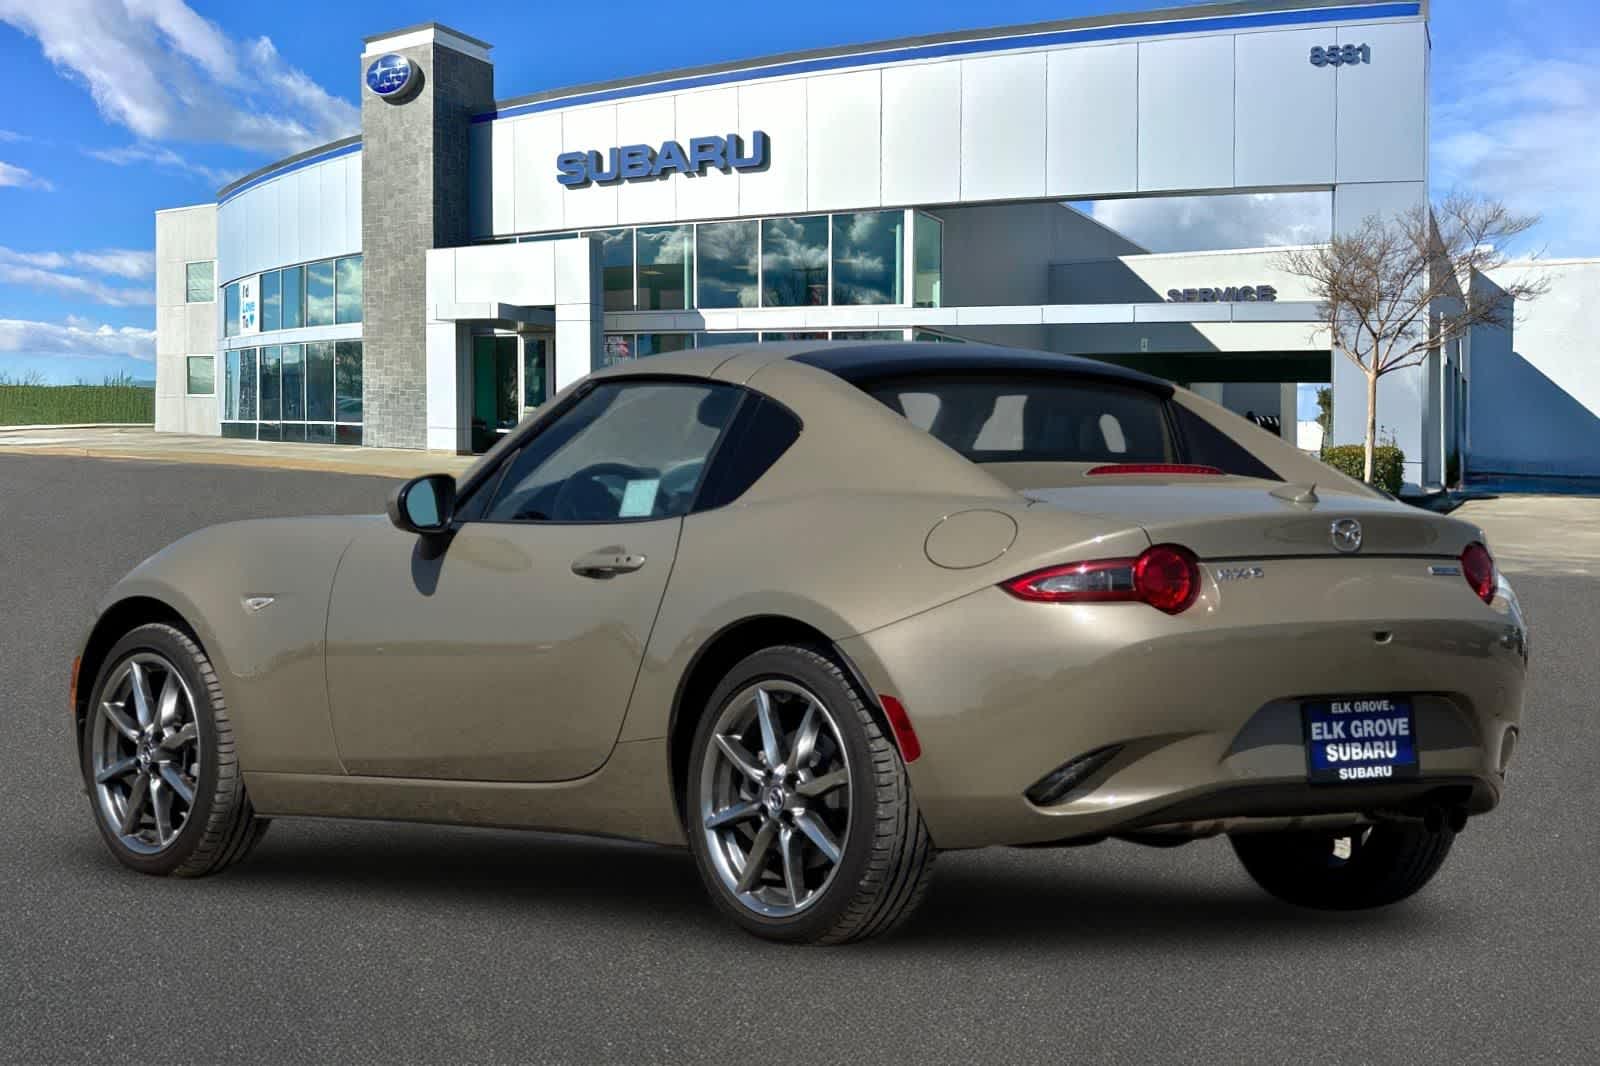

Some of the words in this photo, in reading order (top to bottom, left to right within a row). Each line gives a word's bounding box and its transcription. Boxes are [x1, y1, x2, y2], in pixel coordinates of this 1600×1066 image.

[556, 130, 769, 189] SUBARU
[1166, 285, 1278, 303] SERVICE
[1331, 702, 1352, 714] ELK
[1311, 721, 1346, 740] ELK
[1350, 718, 1410, 738] GROVE
[1326, 740, 1398, 762] SUBARU
[1339, 766, 1393, 780] SUBARU
